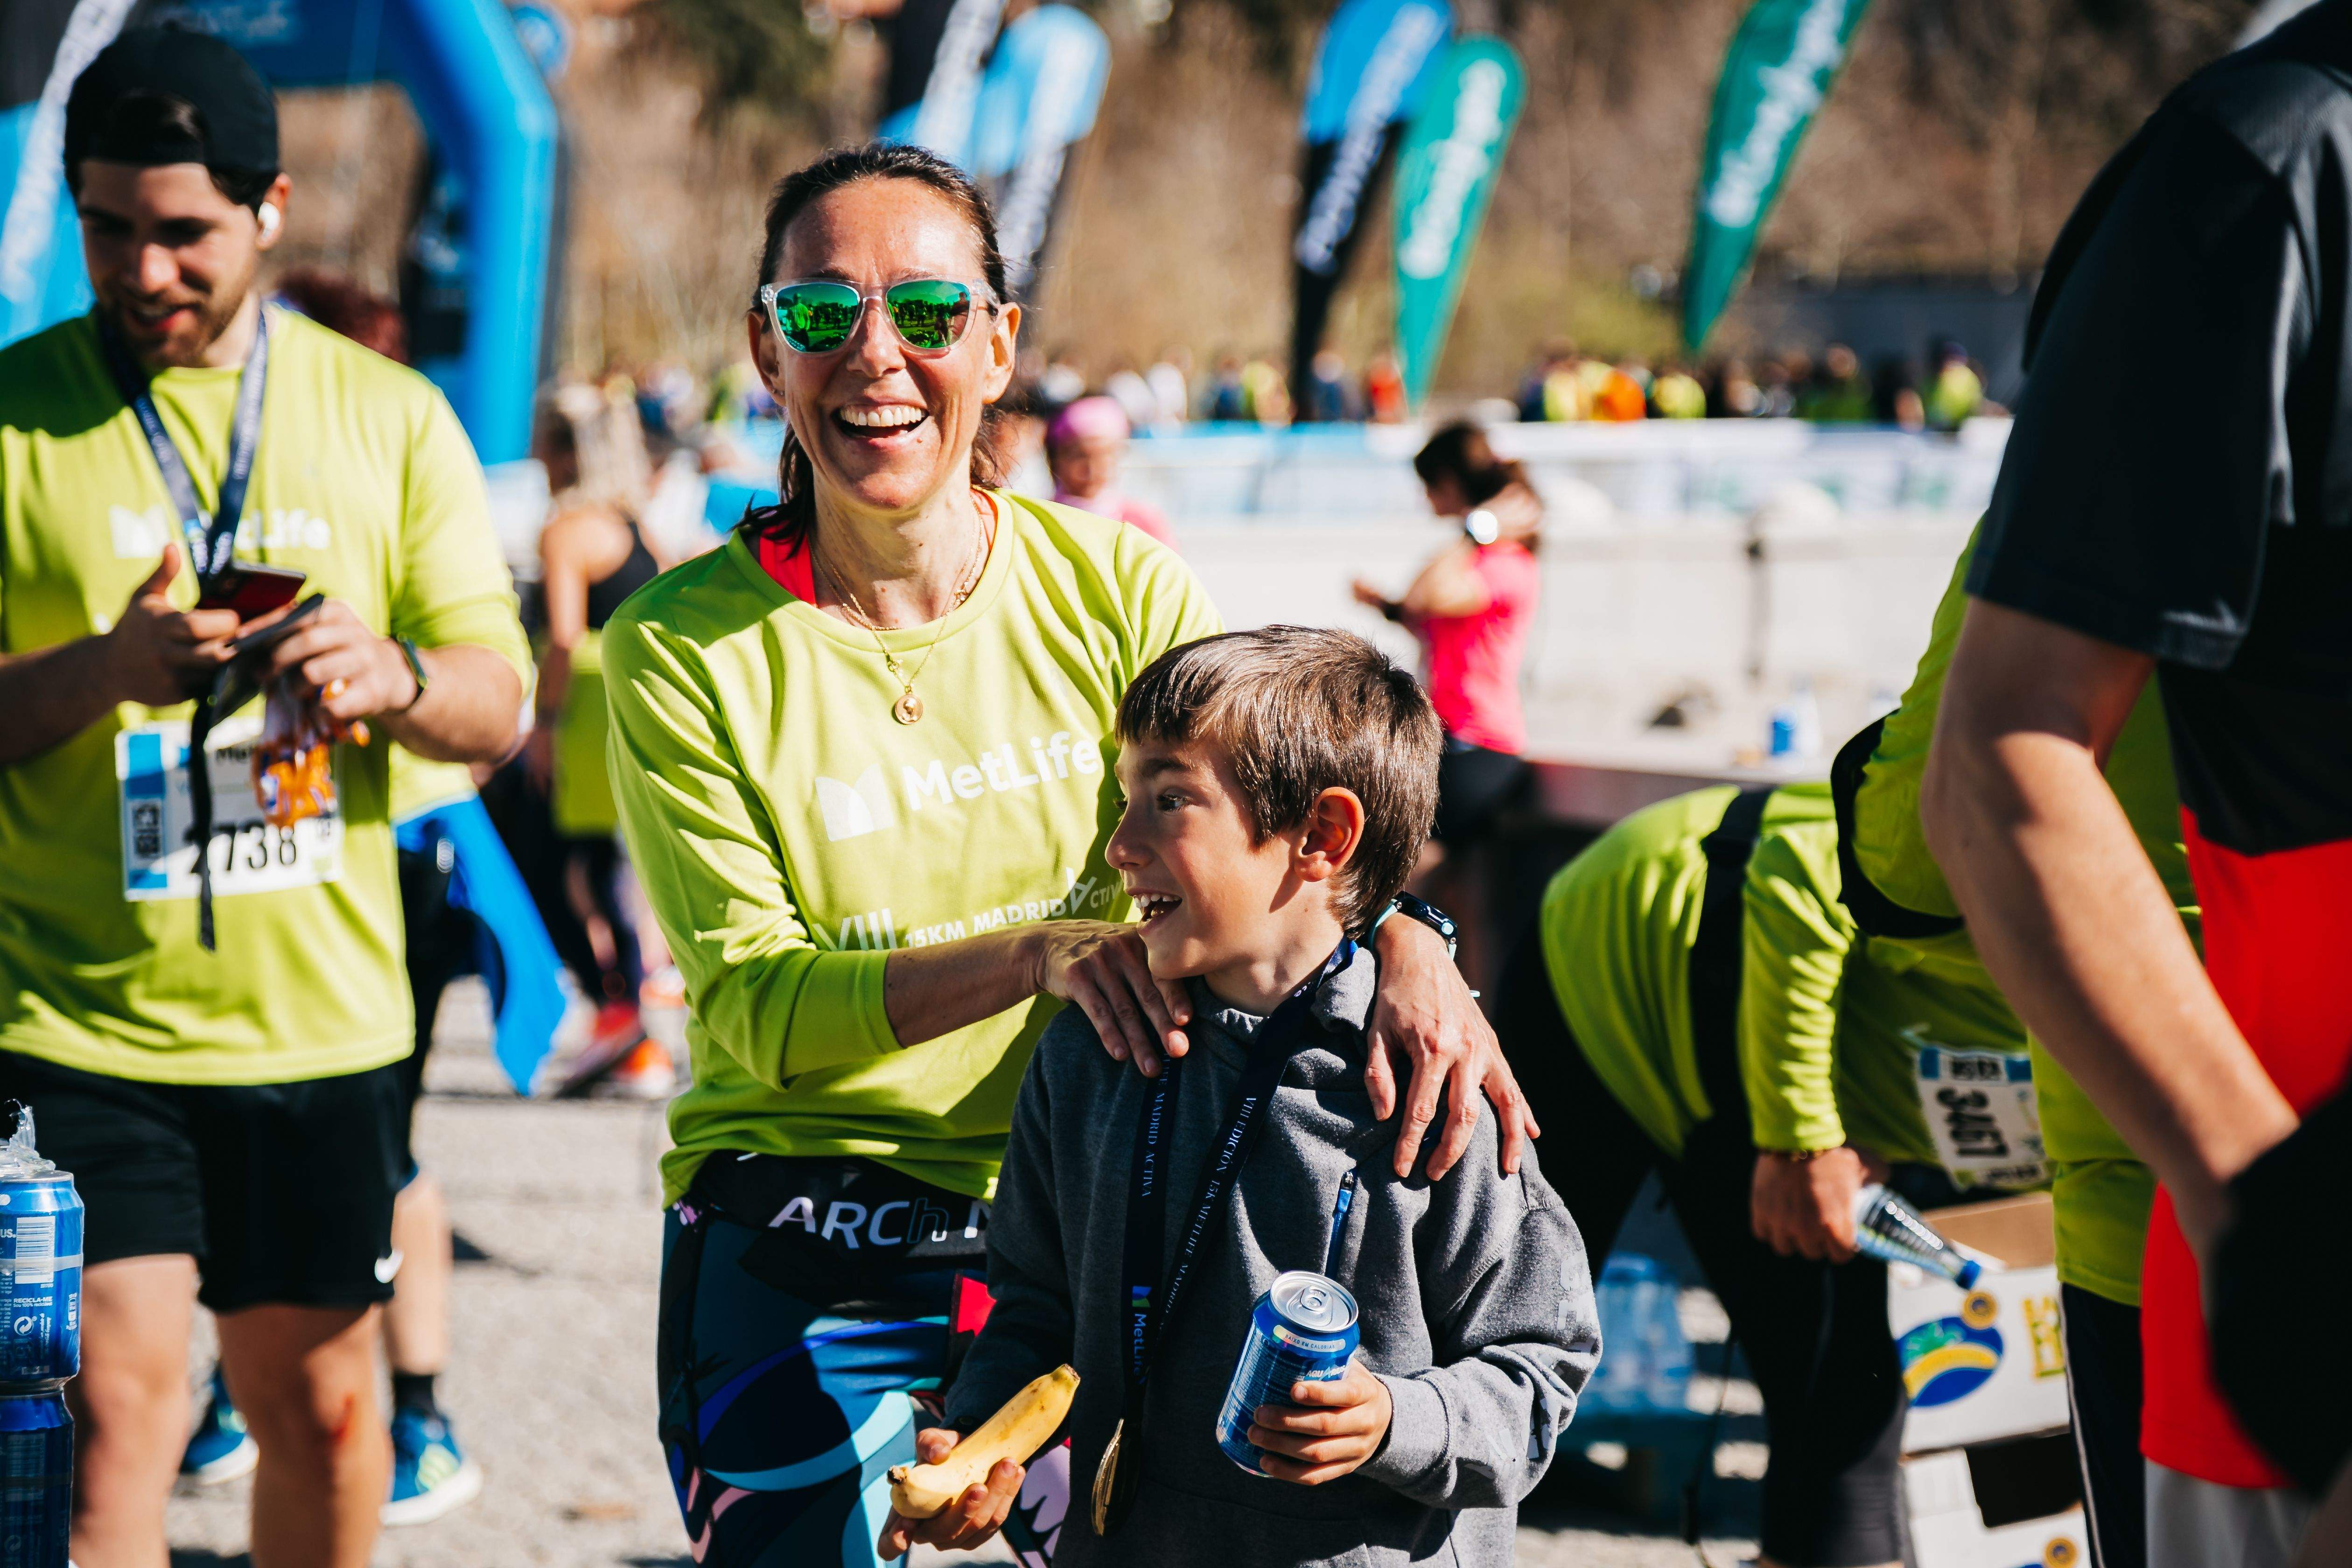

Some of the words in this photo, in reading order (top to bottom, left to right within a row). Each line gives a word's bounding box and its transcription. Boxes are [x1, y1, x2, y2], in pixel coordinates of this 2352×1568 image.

[902, 731, 1100, 811] MetLife
[812, 908, 897, 952] VIII
[905, 920, 966, 948] 15KM
[974, 898, 1066, 934] MADRID
[1066, 867, 1123, 915] ACTIV
[1148, 1091, 1165, 1144] MADRID
[1240, 1098, 1257, 1119] VIII
[1142, 1150, 1155, 1197] ACTIVA
[1205, 1180, 1220, 1201] 15K
[1134, 1313, 1147, 1375] MetLife
[1285, 1334, 1300, 1344] BAIXO
